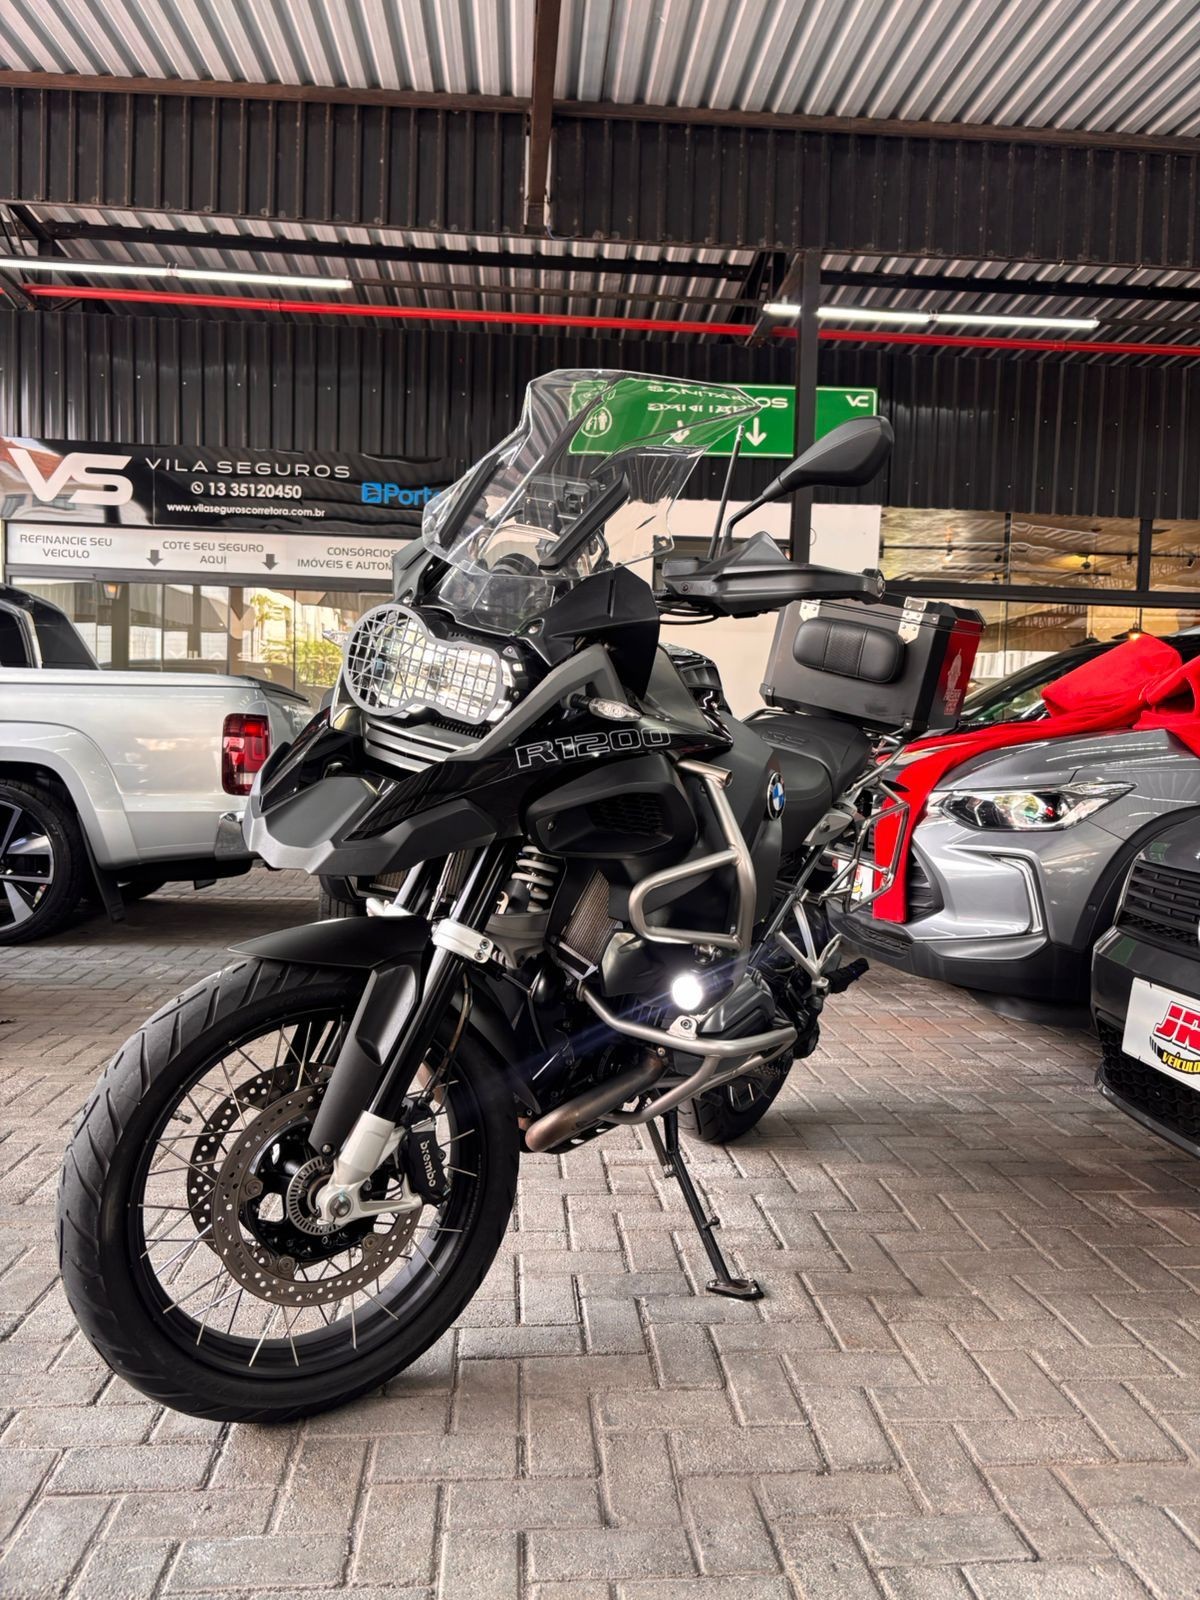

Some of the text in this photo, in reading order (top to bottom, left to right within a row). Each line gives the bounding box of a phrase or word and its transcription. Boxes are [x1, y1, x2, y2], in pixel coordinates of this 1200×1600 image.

[145, 457, 350, 478] VILA SEGUROS
[7, 447, 134, 506] VS
[208, 482, 302, 499] 13 35120450
[383, 483, 441, 505] Port
[166, 503, 325, 517] www.vilaseguroscorretora.com.br
[19, 534, 113, 547] REFINANCIE SEU
[162, 541, 264, 553] COTE SEU SEGURO
[42, 548, 90, 559] VEICULO
[200, 555, 227, 565] AQUI
[297, 557, 343, 569] IMÓVEIS
[345, 560, 353, 569] E
[515, 726, 672, 769] R1200
[420, 1140, 437, 1188] brembo
